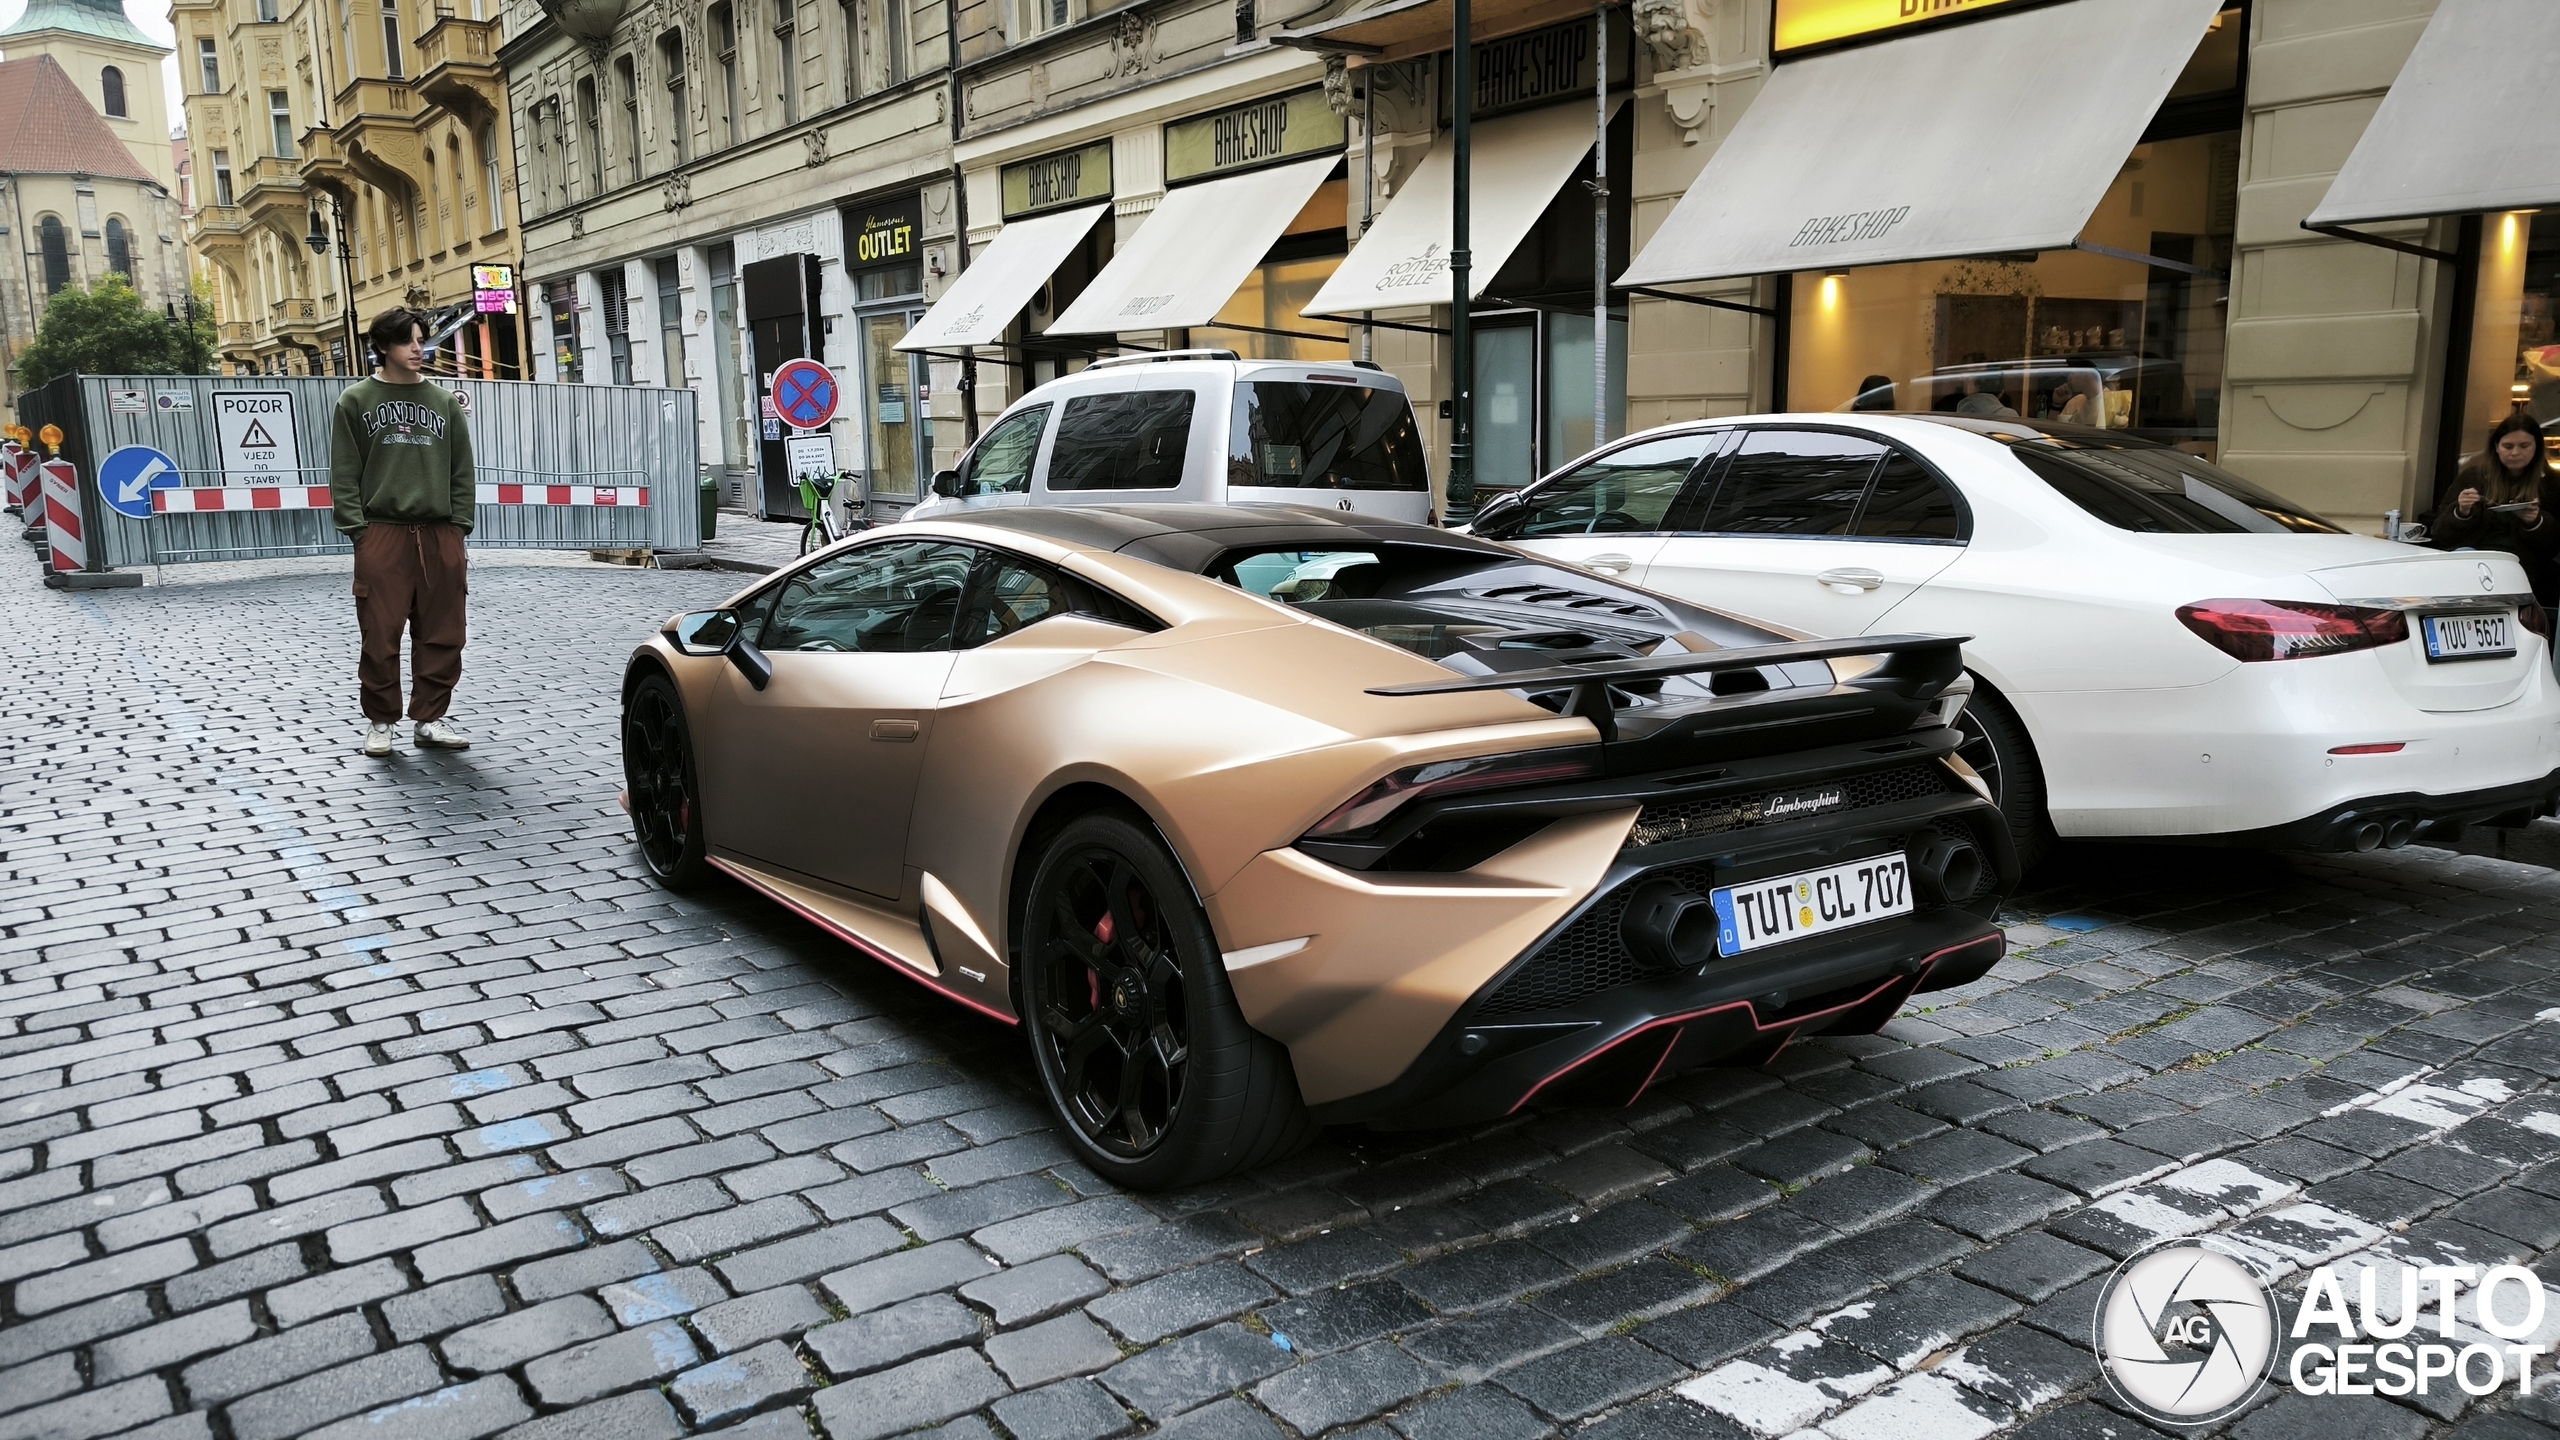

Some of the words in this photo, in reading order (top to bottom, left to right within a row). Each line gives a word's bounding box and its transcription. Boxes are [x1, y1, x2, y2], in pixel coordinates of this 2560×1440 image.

[1478, 24, 1587, 109] BAKESHOP
[1215, 101, 1287, 167] BAKESHOP
[1028, 153, 1081, 207] BAKESHOP
[1788, 206, 1911, 247] BAKESHOP
[859, 225, 911, 260] OUTLET
[1375, 272, 1438, 291] QUELLE
[475, 290, 514, 301] DISCO
[223, 399, 283, 413] POZOR
[362, 401, 446, 440] LONDON
[381, 433, 433, 446] ENGLAND
[243, 451, 275, 460] VJEZD
[49, 478, 69, 494] SYNER
[243, 475, 281, 485] STAVBY
[2440, 620, 2467, 650] 1UU
[2473, 617, 2505, 648] 5627
[1763, 791, 1841, 817] Lamborghini
[1736, 884, 1794, 941] TUT
[1816, 874, 1856, 922] CL
[1857, 860, 1906, 913] 707
[1723, 928, 1734, 944] D
